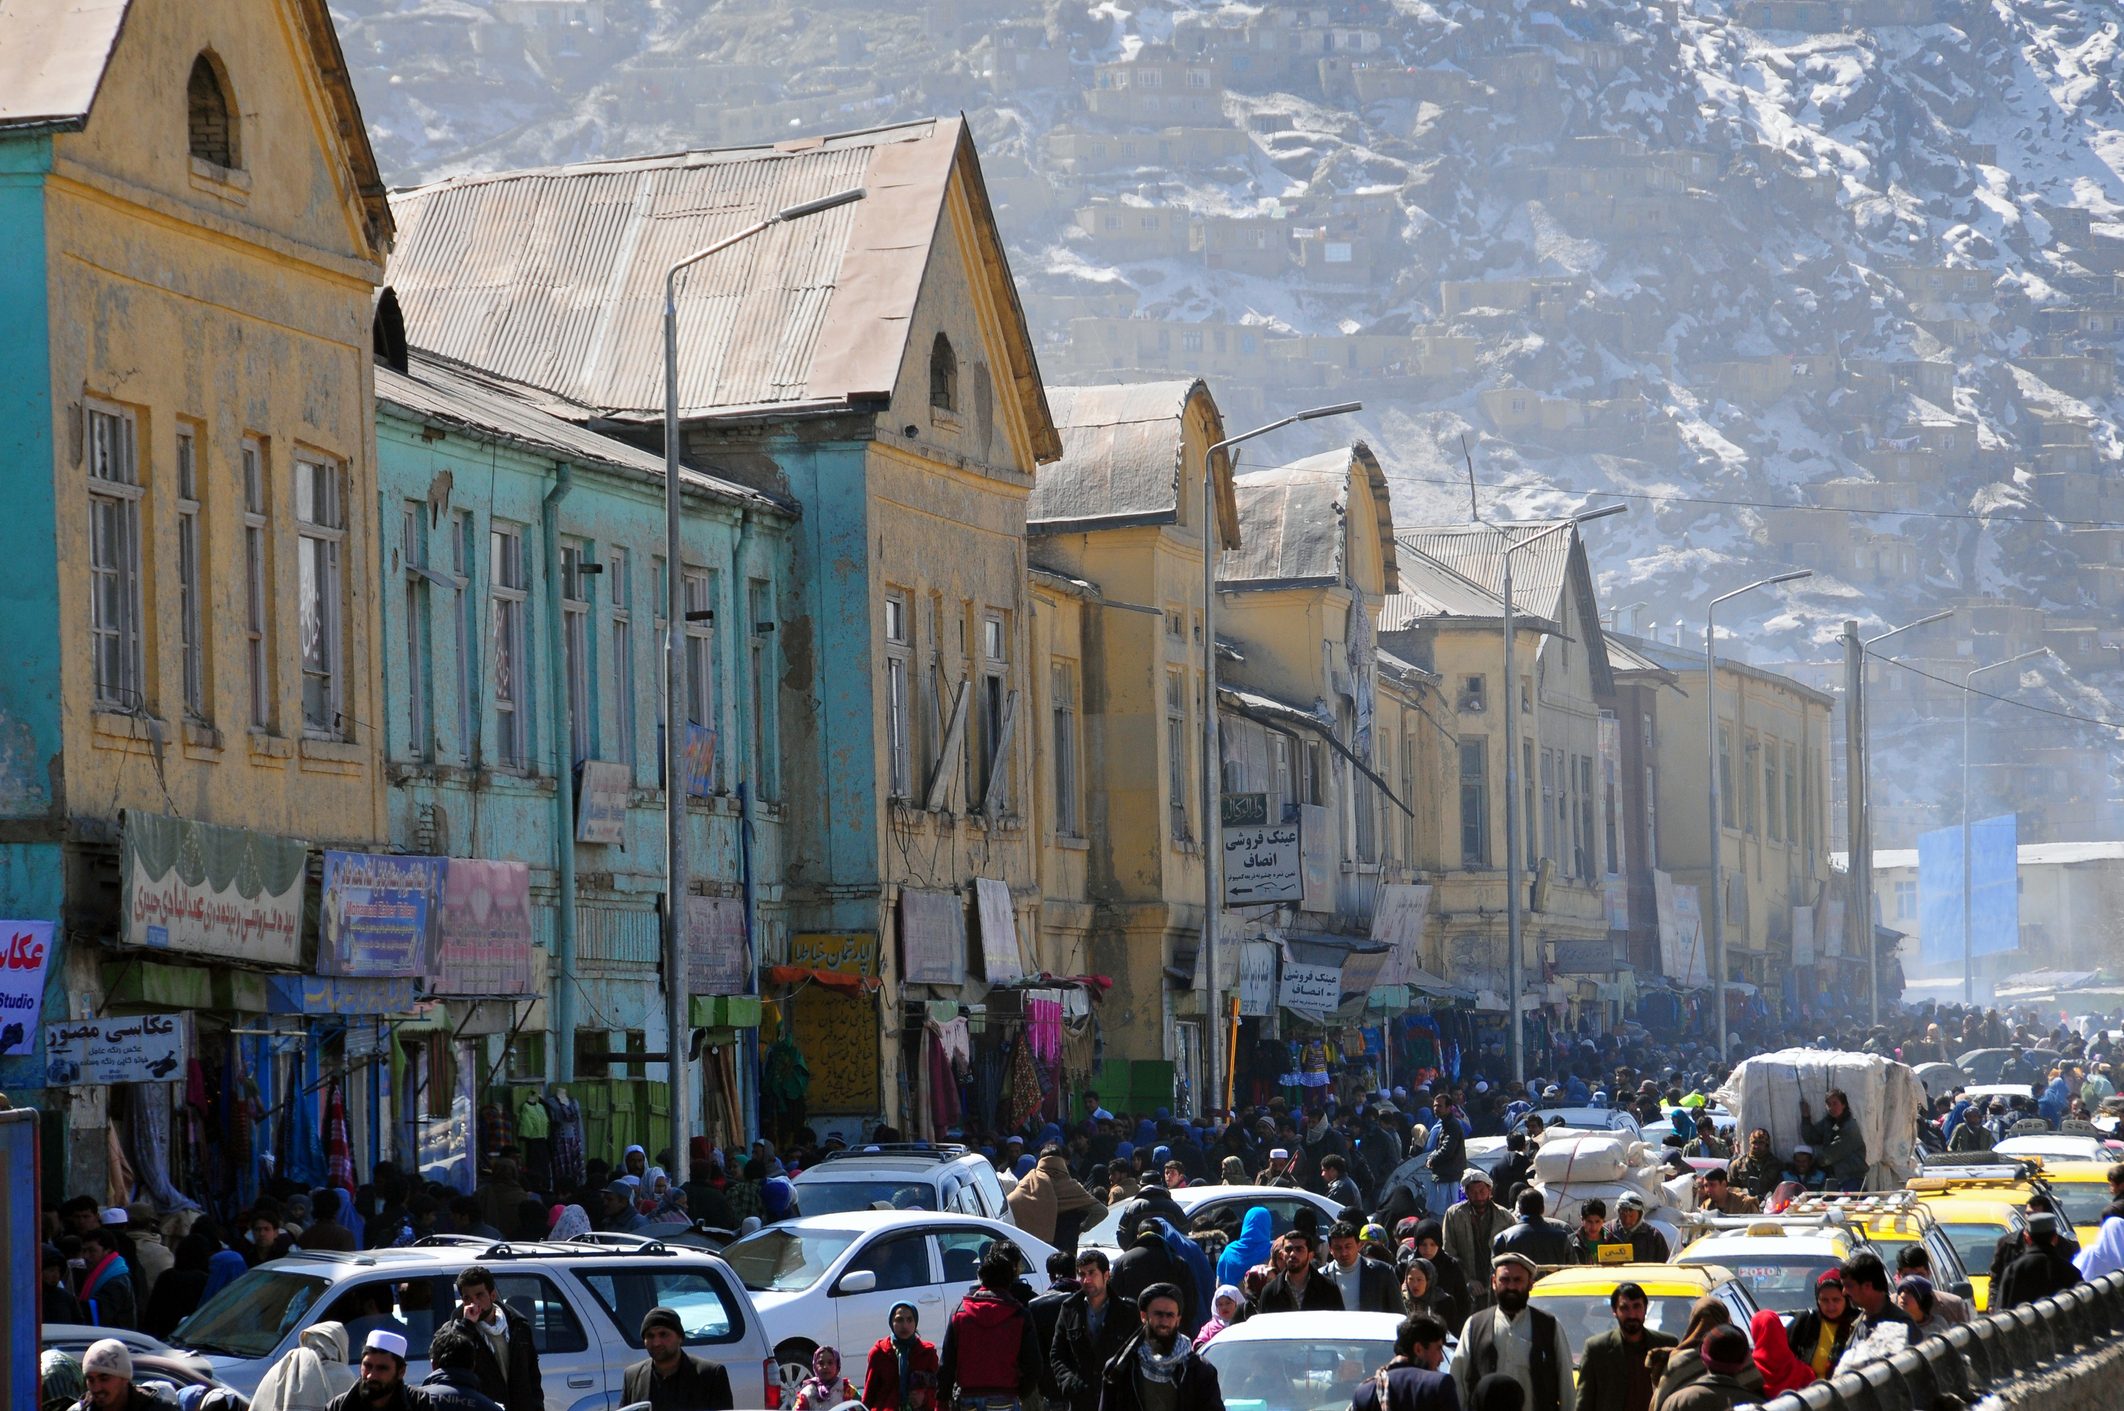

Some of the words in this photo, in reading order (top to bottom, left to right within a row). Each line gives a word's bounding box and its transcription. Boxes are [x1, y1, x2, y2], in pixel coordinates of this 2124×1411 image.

[1225, 829, 1264, 851] فروشی
[1267, 830, 1296, 847] عینک
[1243, 852, 1278, 868] انصاف
[1283, 970, 1313, 983] فروشی
[1315, 973, 1337, 986] عینک
[1292, 984, 1324, 996] انصاف
[47, 1026, 100, 1047] مصور
[106, 1015, 174, 1043] عکاسی
